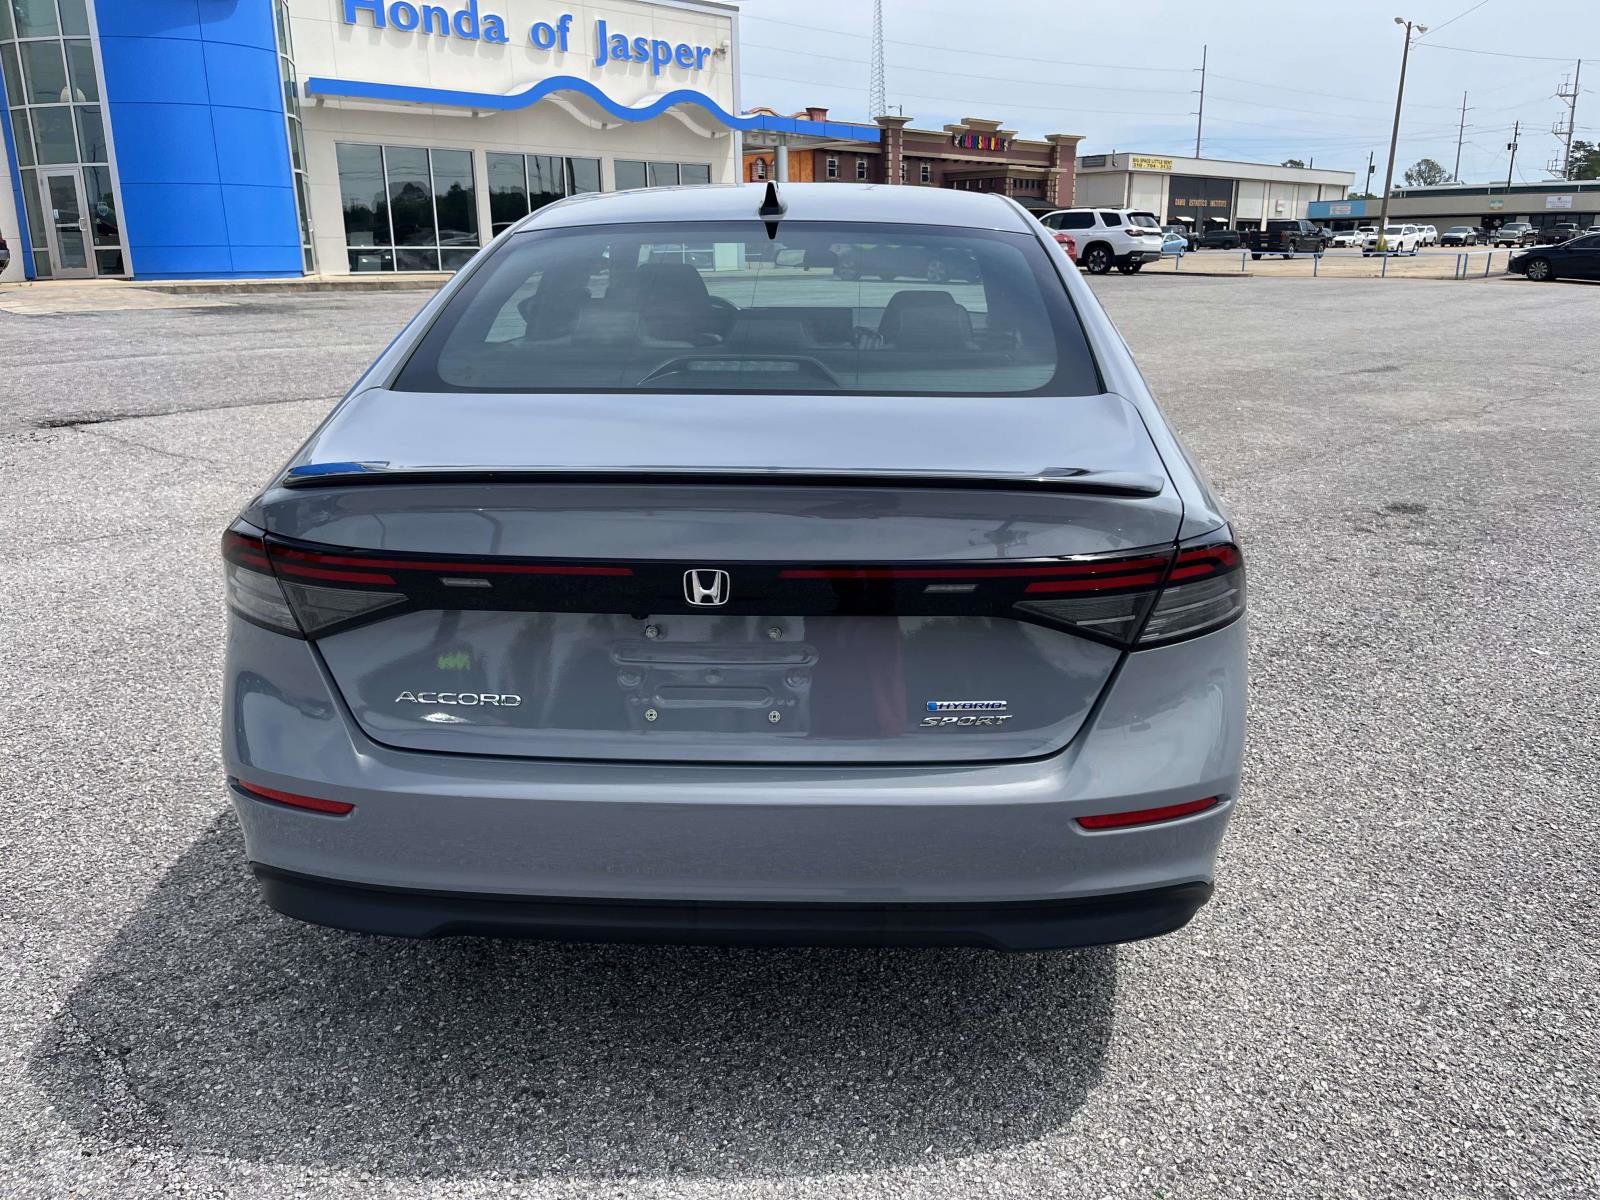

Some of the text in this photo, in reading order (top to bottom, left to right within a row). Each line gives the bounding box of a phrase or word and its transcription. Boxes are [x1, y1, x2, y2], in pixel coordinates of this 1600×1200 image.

[342, 0, 711, 76] Honda of Jasper
[395, 691, 522, 707] ACCORD
[937, 702, 1003, 710] HYBRID
[919, 714, 1013, 727] SPORT
